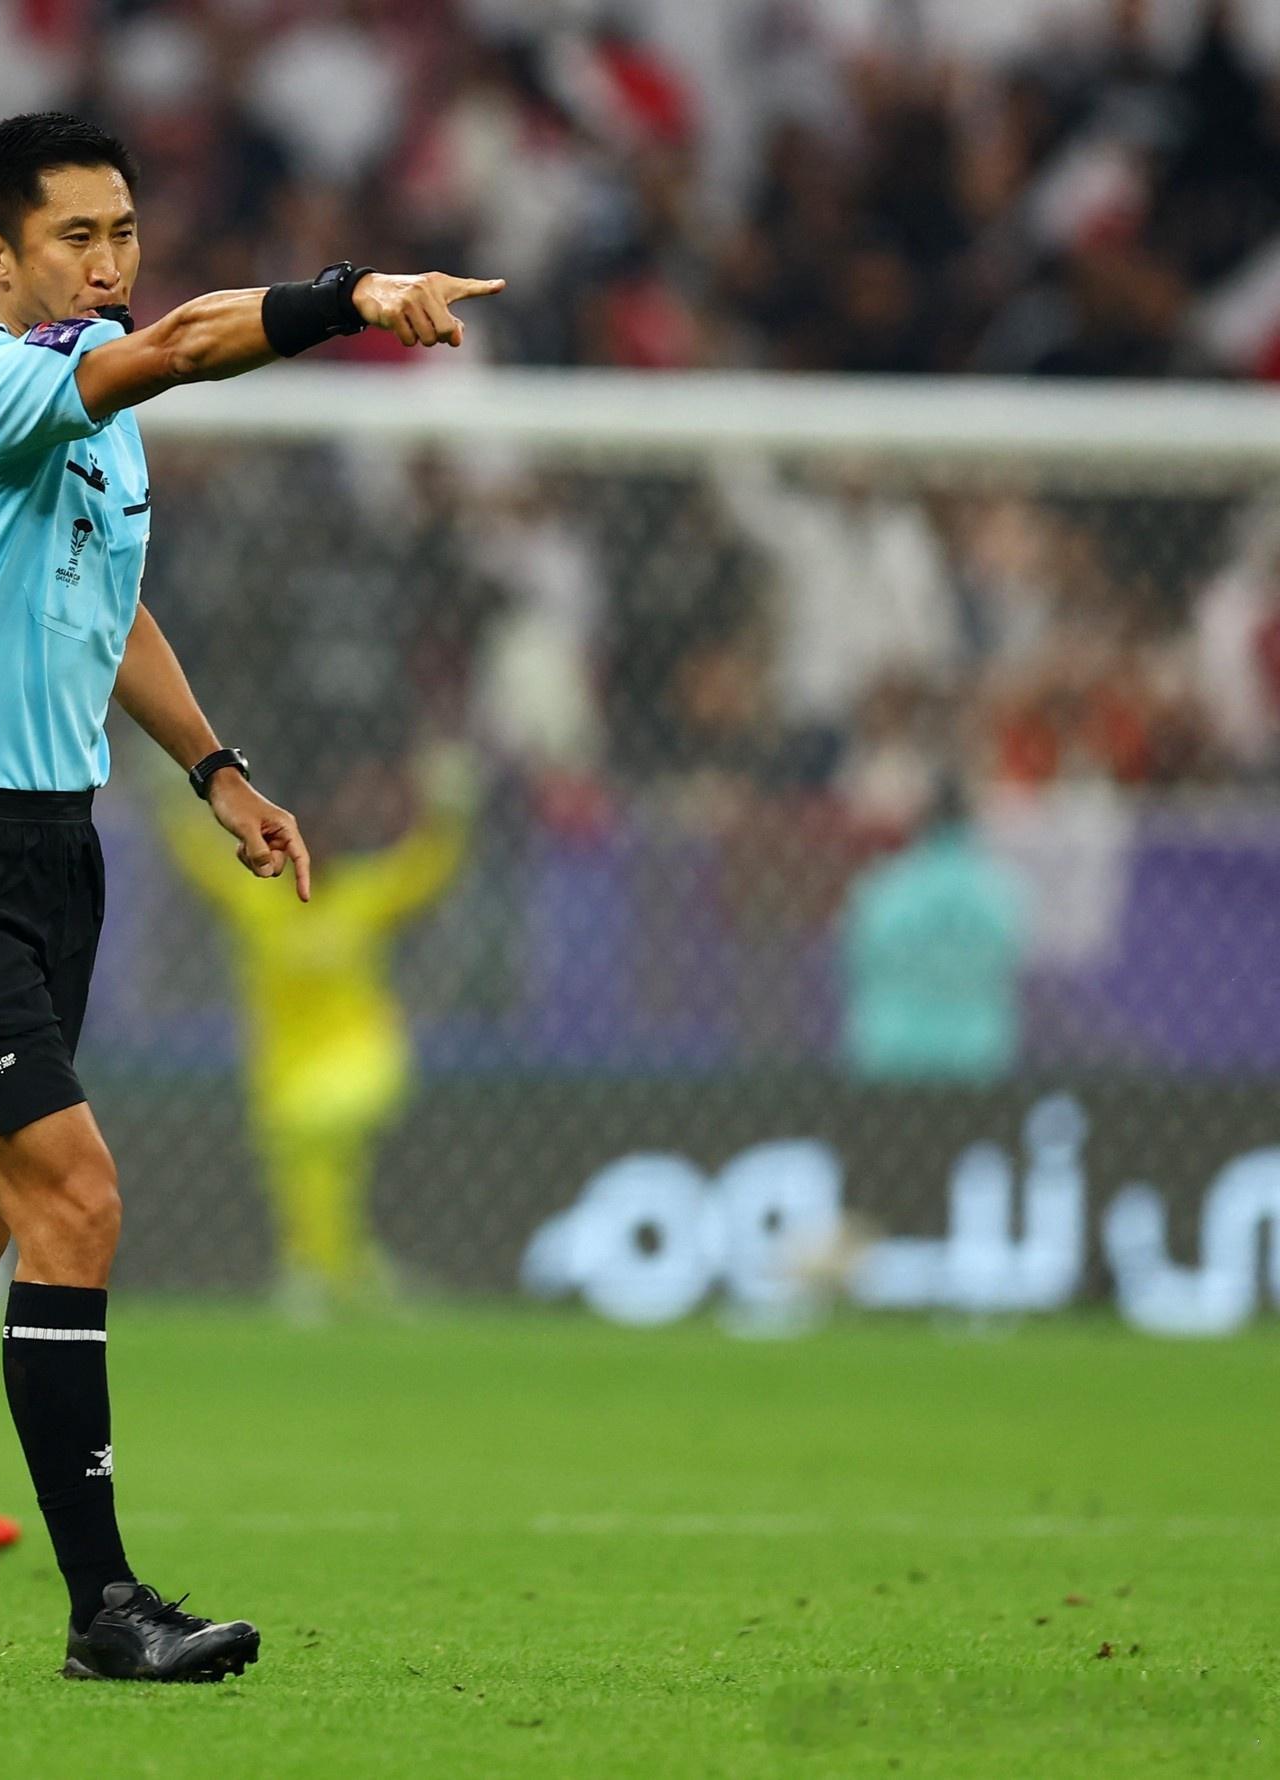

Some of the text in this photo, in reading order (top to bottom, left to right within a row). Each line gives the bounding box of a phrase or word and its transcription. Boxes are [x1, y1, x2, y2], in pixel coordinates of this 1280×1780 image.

[55, 567, 73, 578] ASIAN
[0, 1052, 15, 1063] CUP
[85, 1467, 113, 1477] KEL
